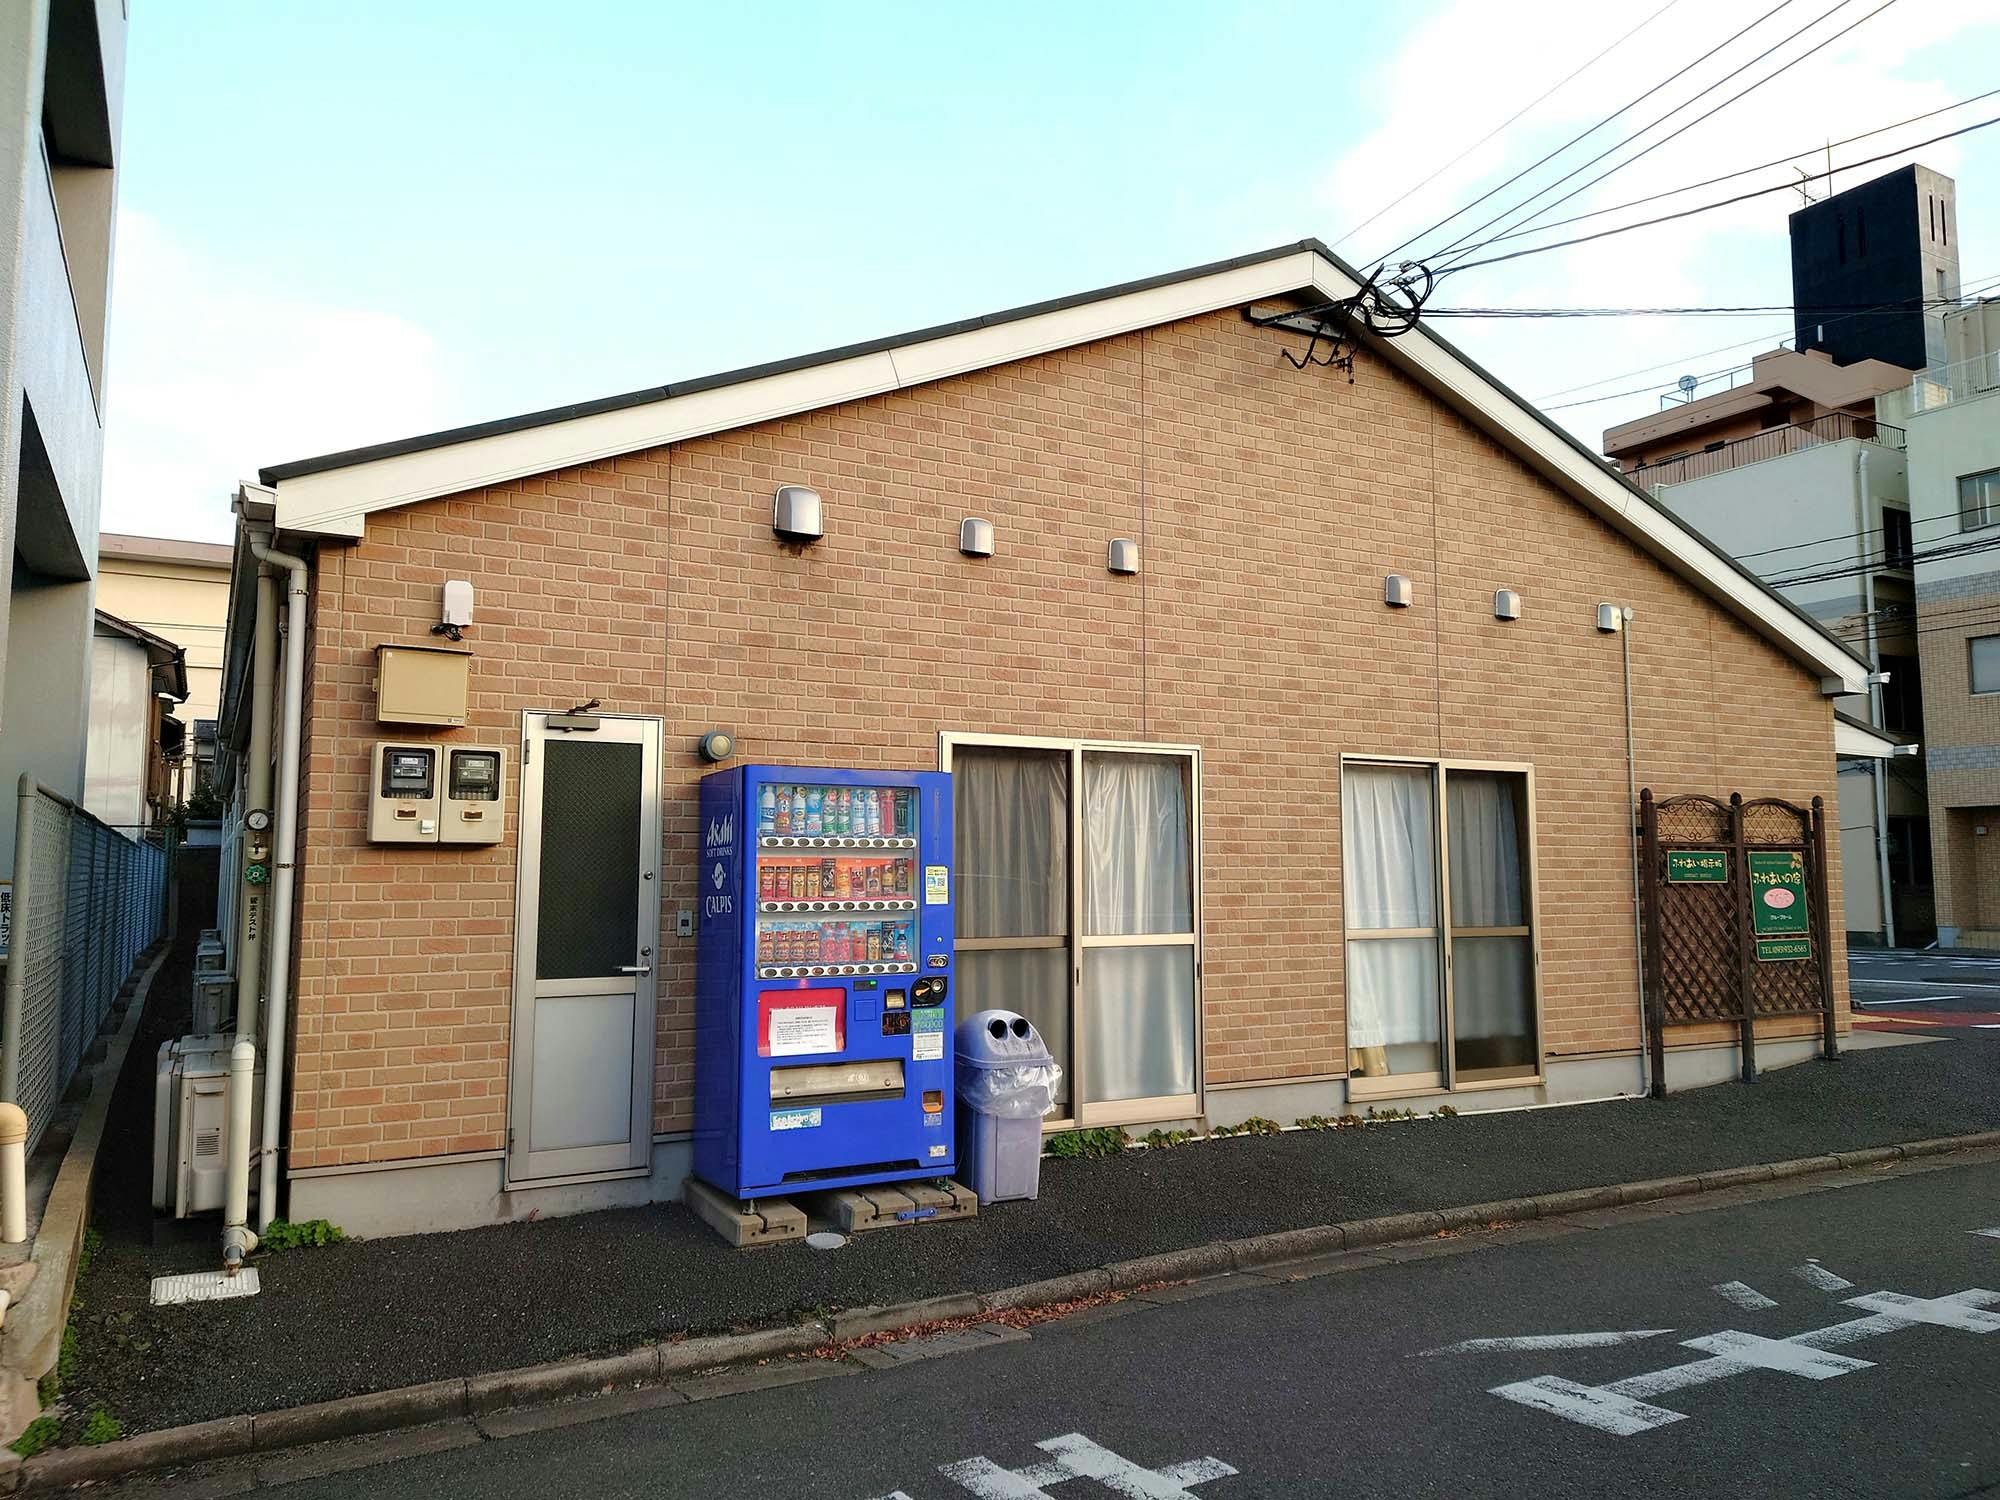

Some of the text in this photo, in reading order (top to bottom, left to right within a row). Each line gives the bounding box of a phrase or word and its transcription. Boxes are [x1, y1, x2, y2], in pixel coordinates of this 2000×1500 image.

[707, 815, 733, 847] Asahi
[706, 846, 733, 858] SOFT DRINKS
[1, 892, 12, 946] 低床トラッ
[705, 896, 732, 918] CALPIS
